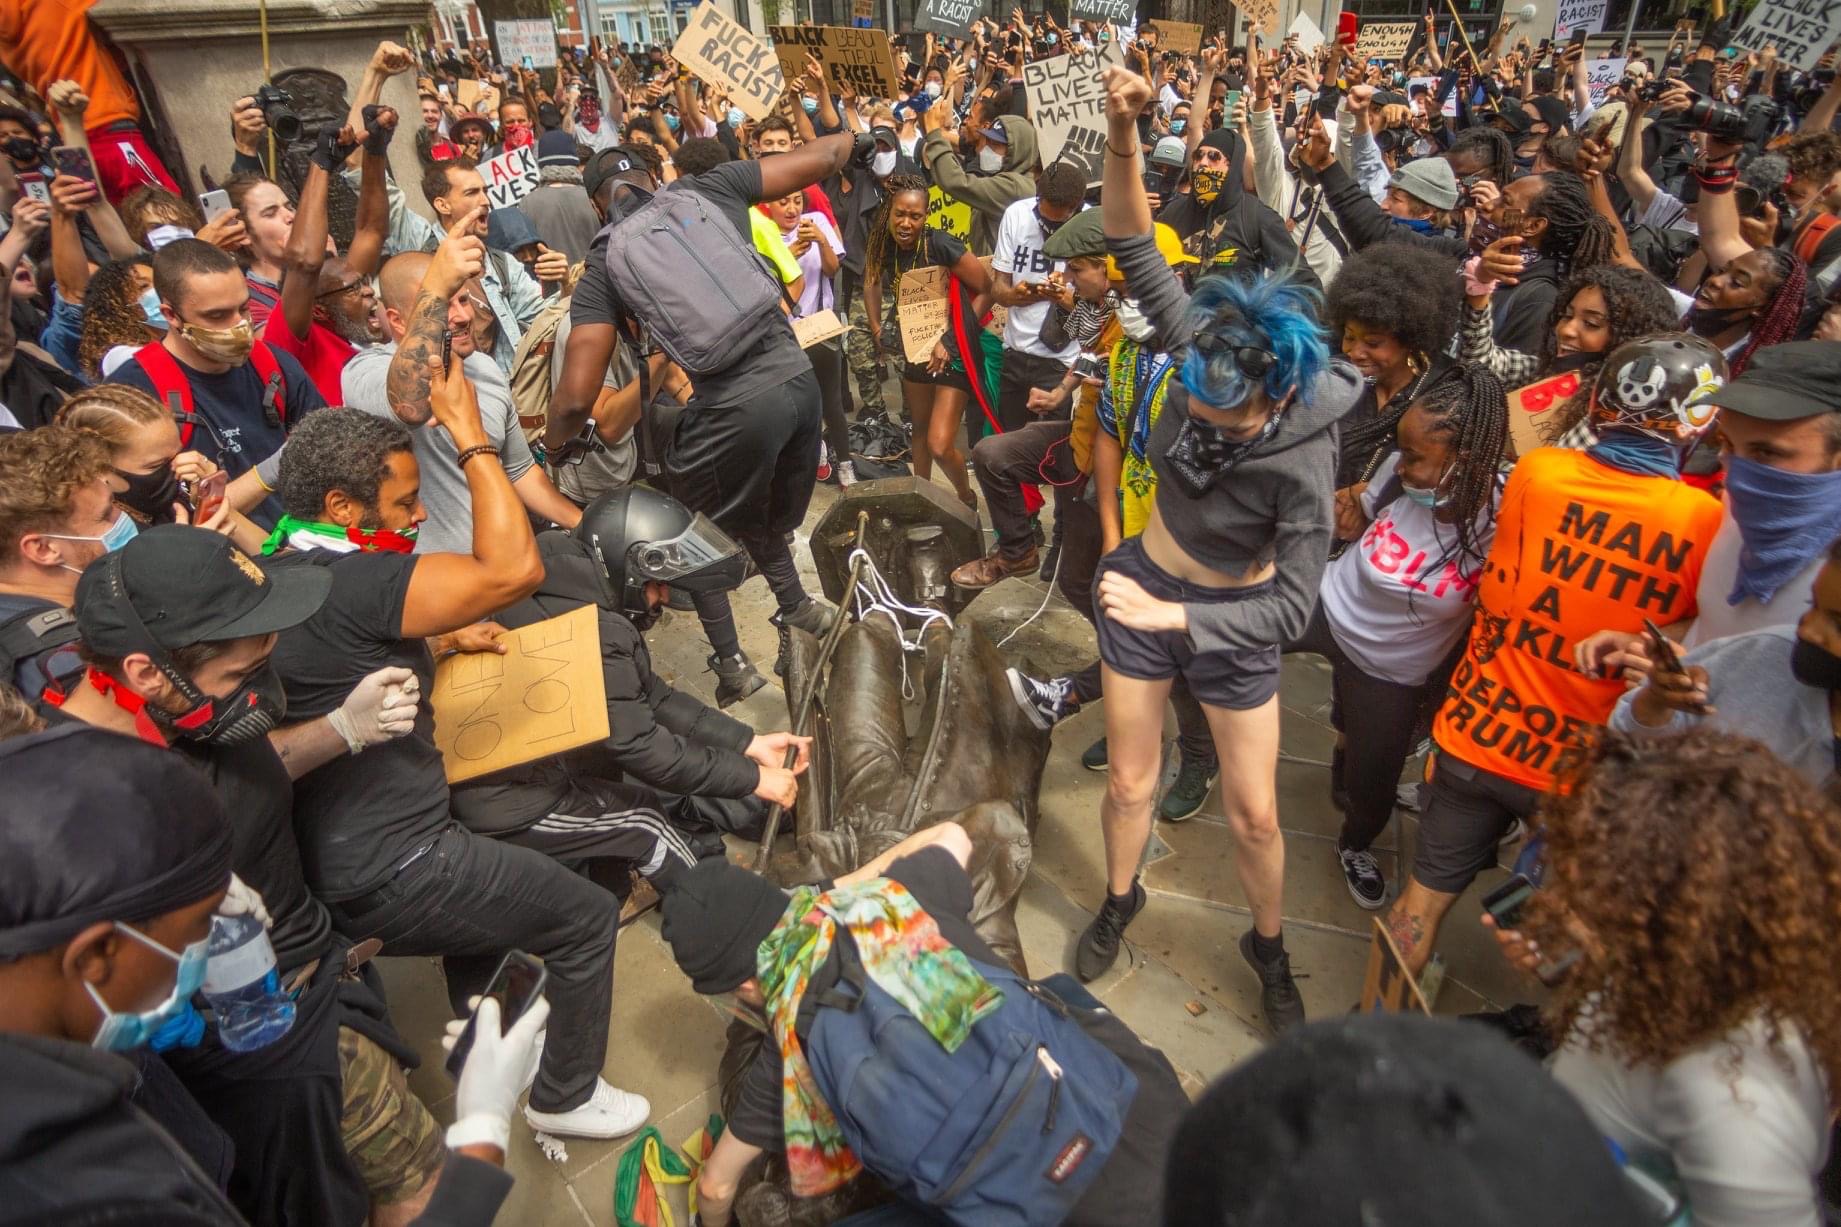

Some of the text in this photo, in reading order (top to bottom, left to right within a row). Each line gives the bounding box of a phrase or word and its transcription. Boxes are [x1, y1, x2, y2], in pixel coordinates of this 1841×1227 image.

[939, 1, 973, 23] RACIST
[1075, 0, 1129, 20] MATTER
[1558, 4, 1606, 24] RACIST
[1761, 8, 1828, 43] LIVES
[1766, 0, 1841, 23] LACK
[700, 8, 783, 88] FUCK A
[769, 26, 828, 46] BLACK
[1356, 40, 1408, 48] ENOUGH
[1362, 25, 1415, 37] ENOUGH
[1733, 25, 1808, 64] MATTER
[699, 38, 781, 107] RACIST
[830, 63, 886, 84] EXCEL
[838, 49, 884, 64] TIFUL
[1024, 45, 1113, 87] BLACK
[1037, 96, 1107, 129] MATTE
[490, 148, 535, 186] ACK
[1559, 502, 1694, 573] MAN
[1363, 518, 1481, 602] #BLM
[1540, 538, 1681, 614] WITH
[1529, 585, 1561, 622] A
[519, 619, 576, 745] LOVE
[1454, 660, 1594, 747] DEPOR
